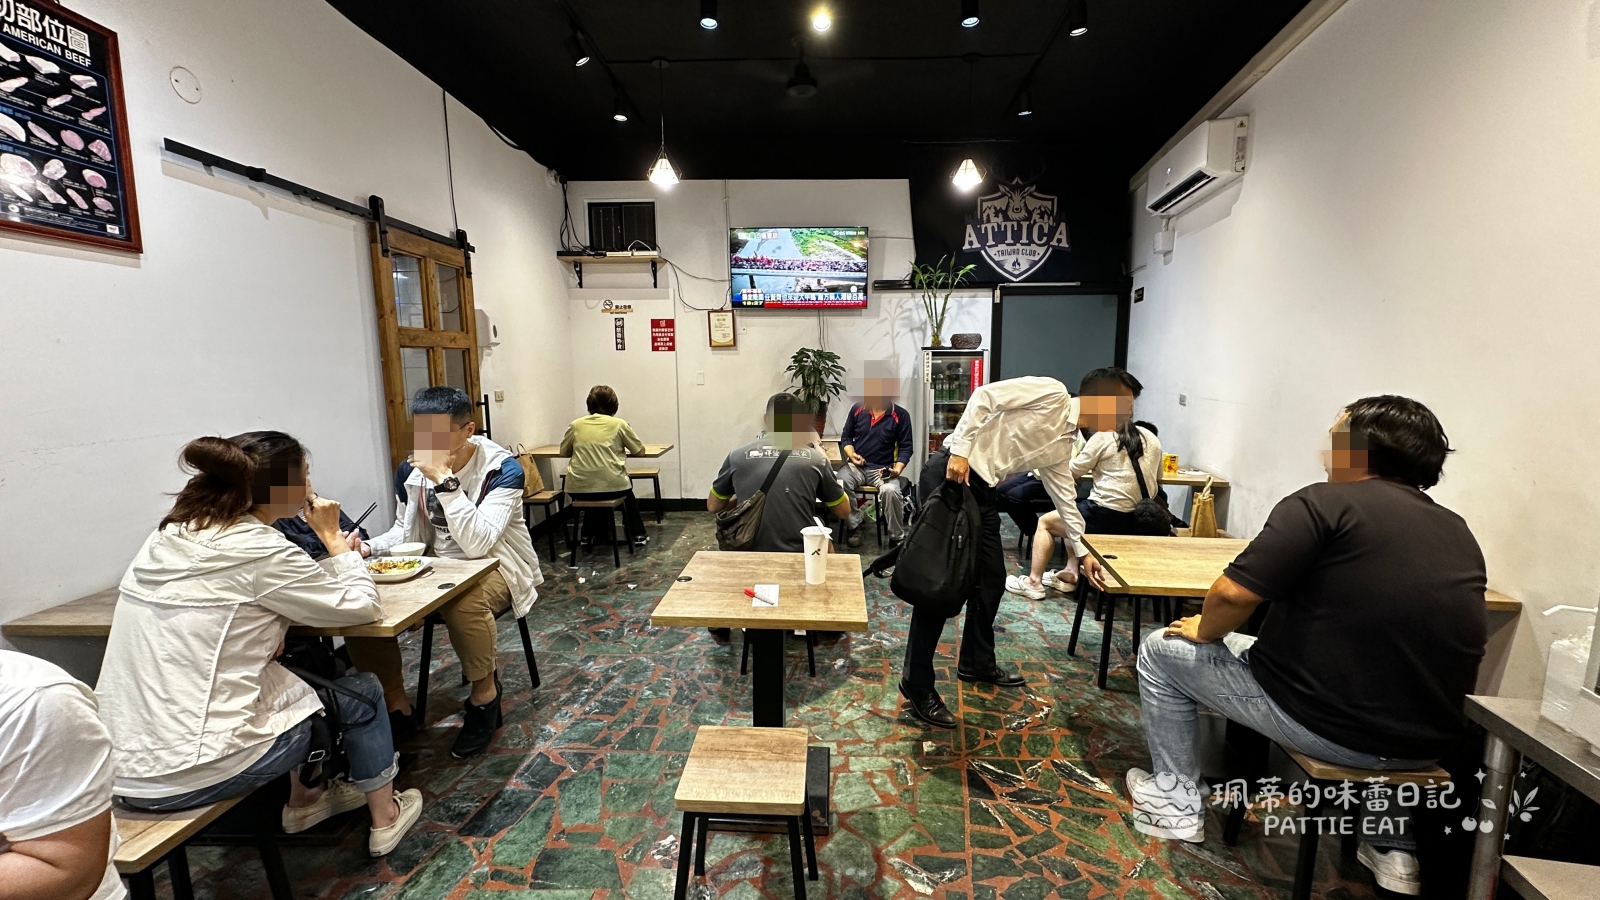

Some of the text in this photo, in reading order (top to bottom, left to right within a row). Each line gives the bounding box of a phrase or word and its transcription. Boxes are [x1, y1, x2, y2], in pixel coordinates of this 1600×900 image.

[3, 23, 92, 67] AMERICAN BEEF
[962, 221, 1070, 250] ATTICA
[996, 249, 1037, 258] TAIWAN CLUB
